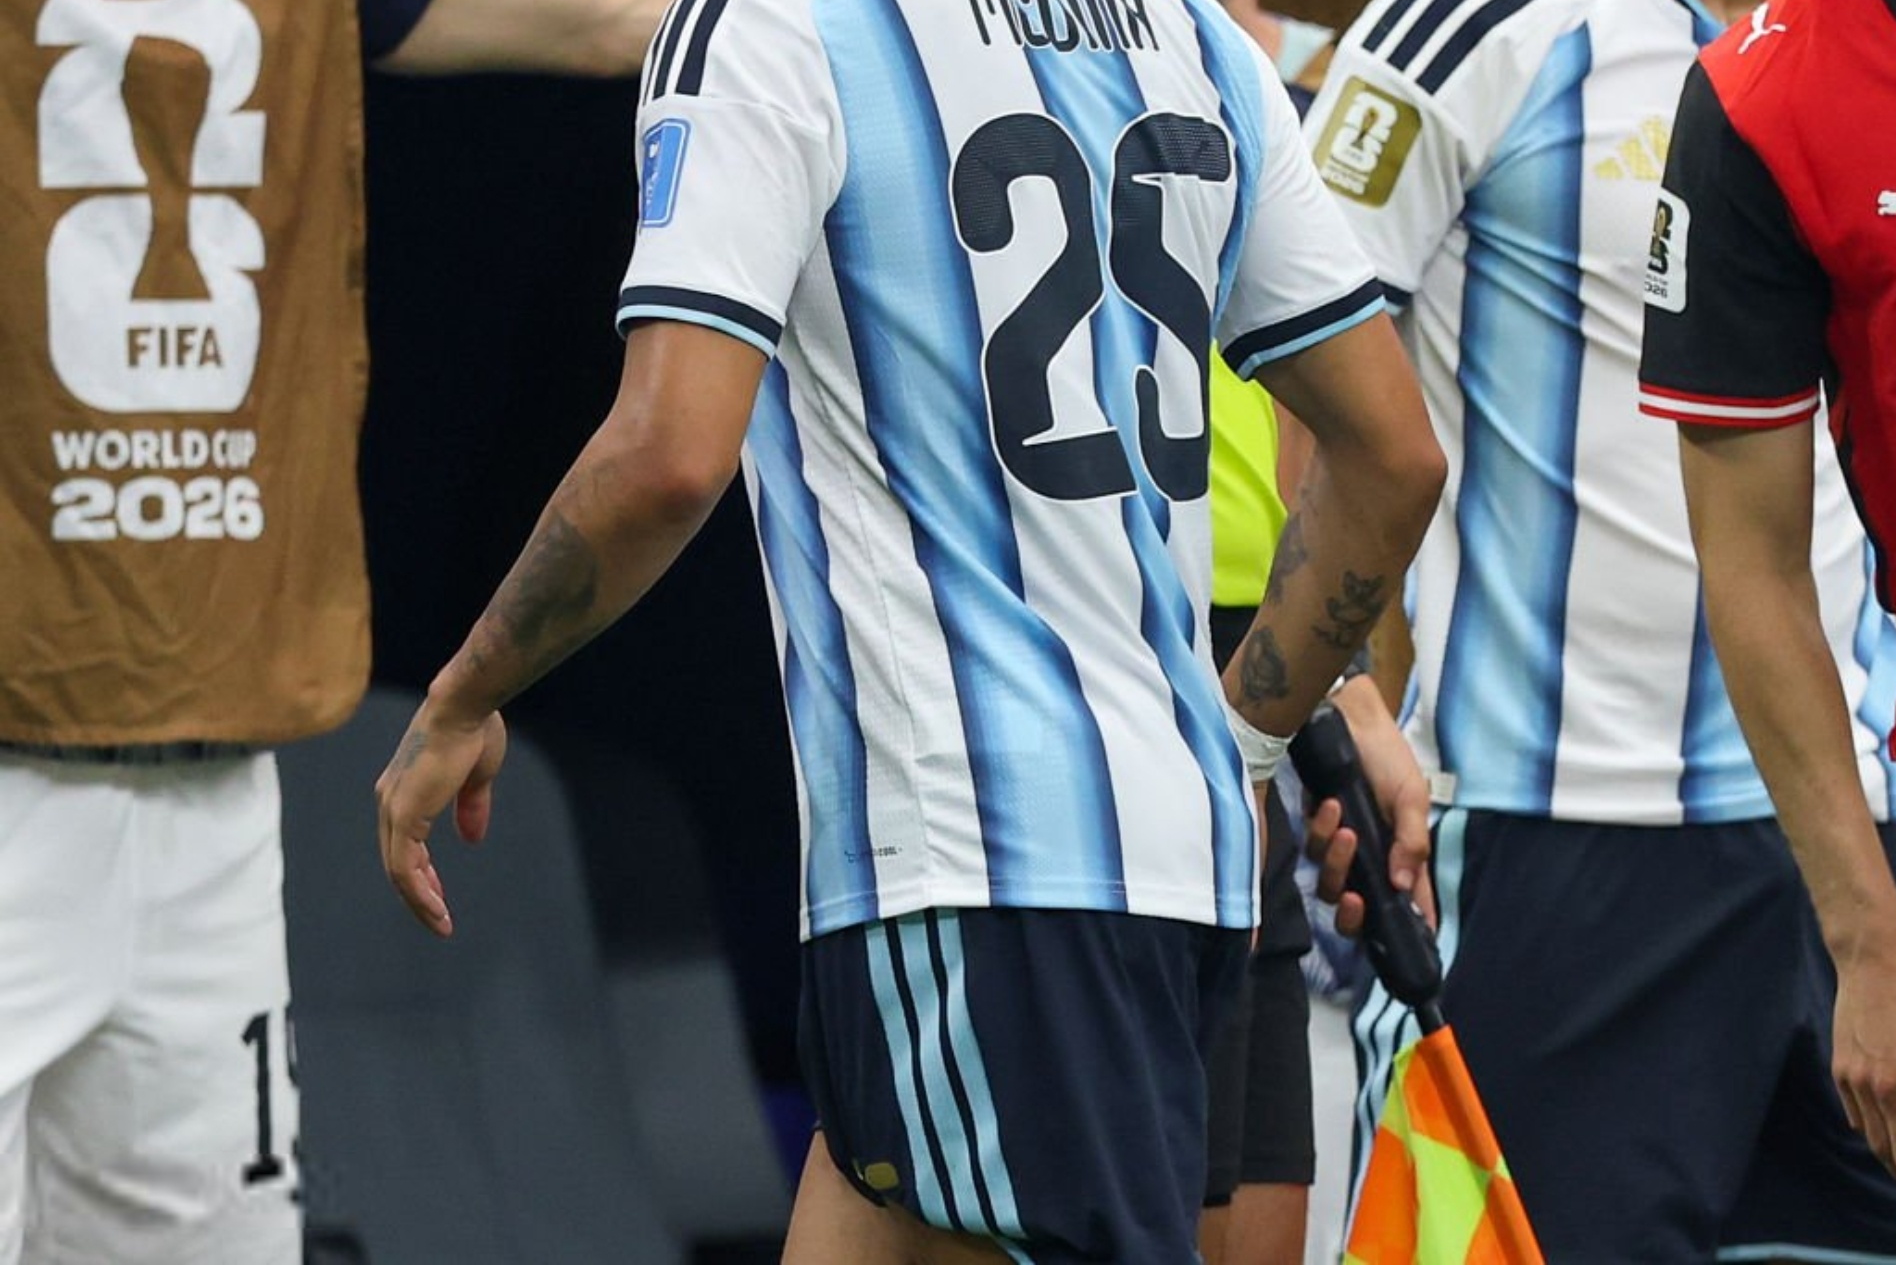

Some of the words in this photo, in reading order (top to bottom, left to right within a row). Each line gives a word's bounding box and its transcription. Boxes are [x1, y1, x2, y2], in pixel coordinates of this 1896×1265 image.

[951, 111, 1234, 502] 25
[126, 326, 223, 369] FIFA
[51, 430, 212, 471] WORLD
[212, 428, 256, 471] CUP
[51, 475, 265, 541] 2026
